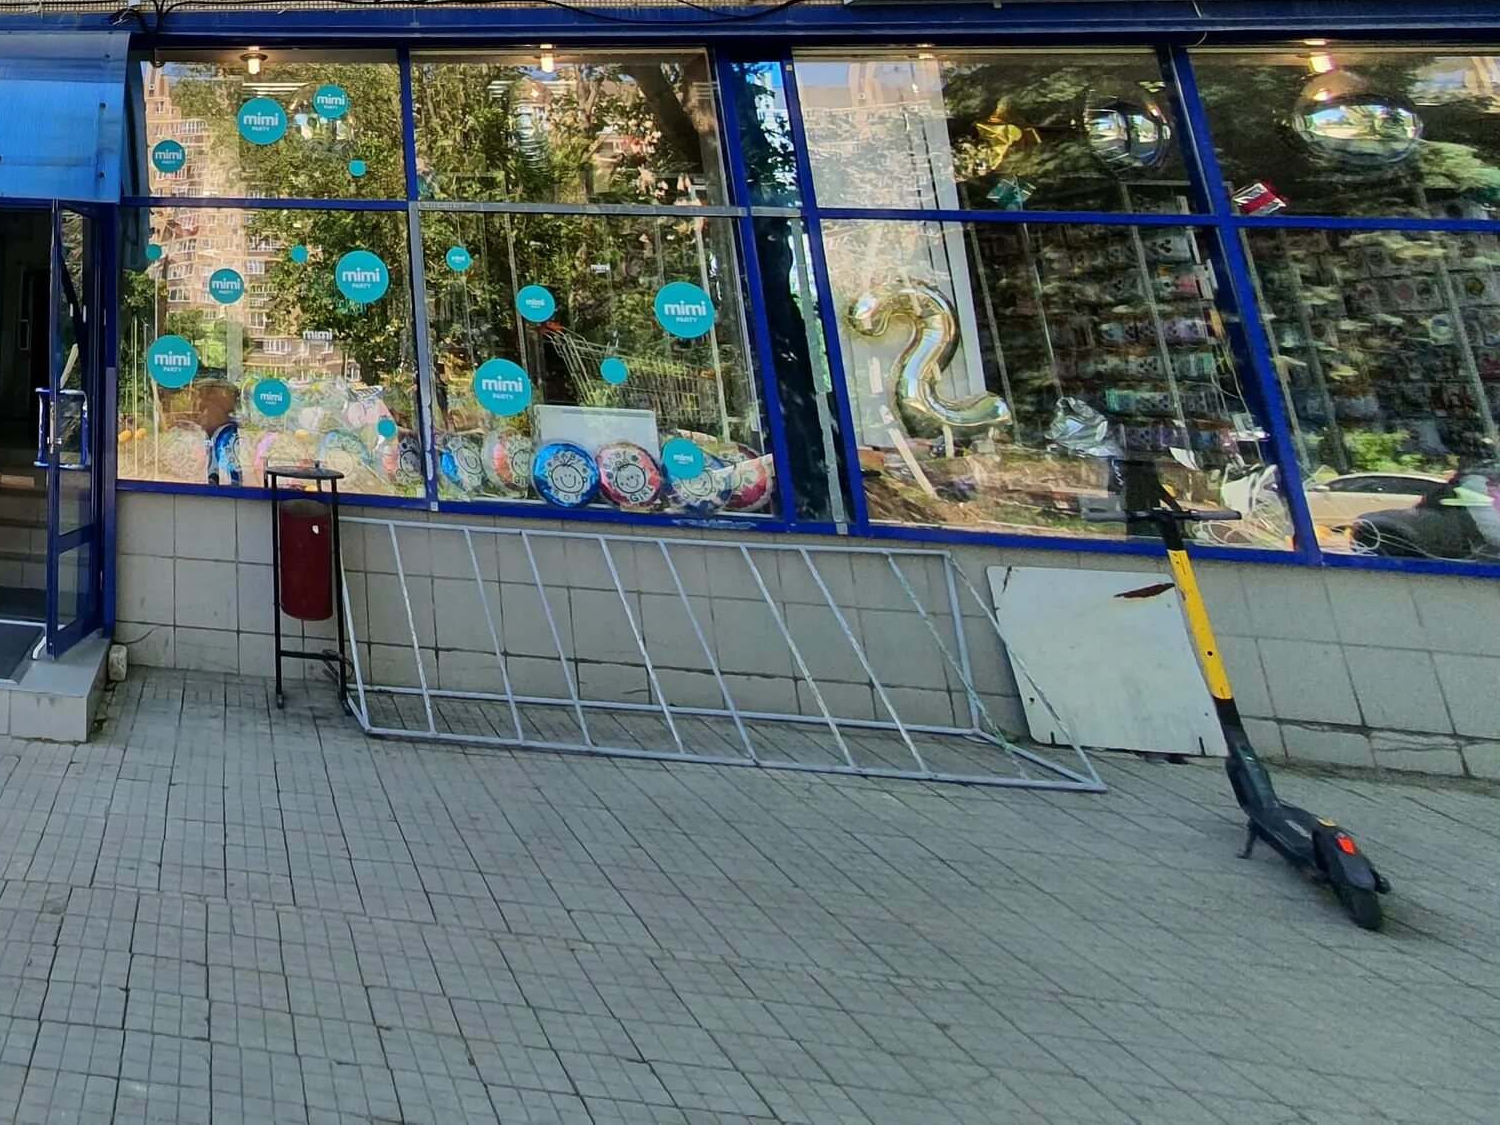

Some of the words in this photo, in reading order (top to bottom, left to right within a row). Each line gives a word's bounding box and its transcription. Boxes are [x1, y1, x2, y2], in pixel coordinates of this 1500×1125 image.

[316, 93, 346, 106] mimi
[243, 112, 279, 126] mimi
[154, 149, 183, 160] mimi
[342, 267, 381, 283] mimi
[211, 277, 241, 290] mimi
[664, 301, 706, 316] mimi
[303, 329, 334, 342] mimi
[154, 351, 192, 367] mimi
[482, 376, 523, 392] mimi
[259, 391, 283, 402] mimi
[629, 484, 655, 503] GIRL
